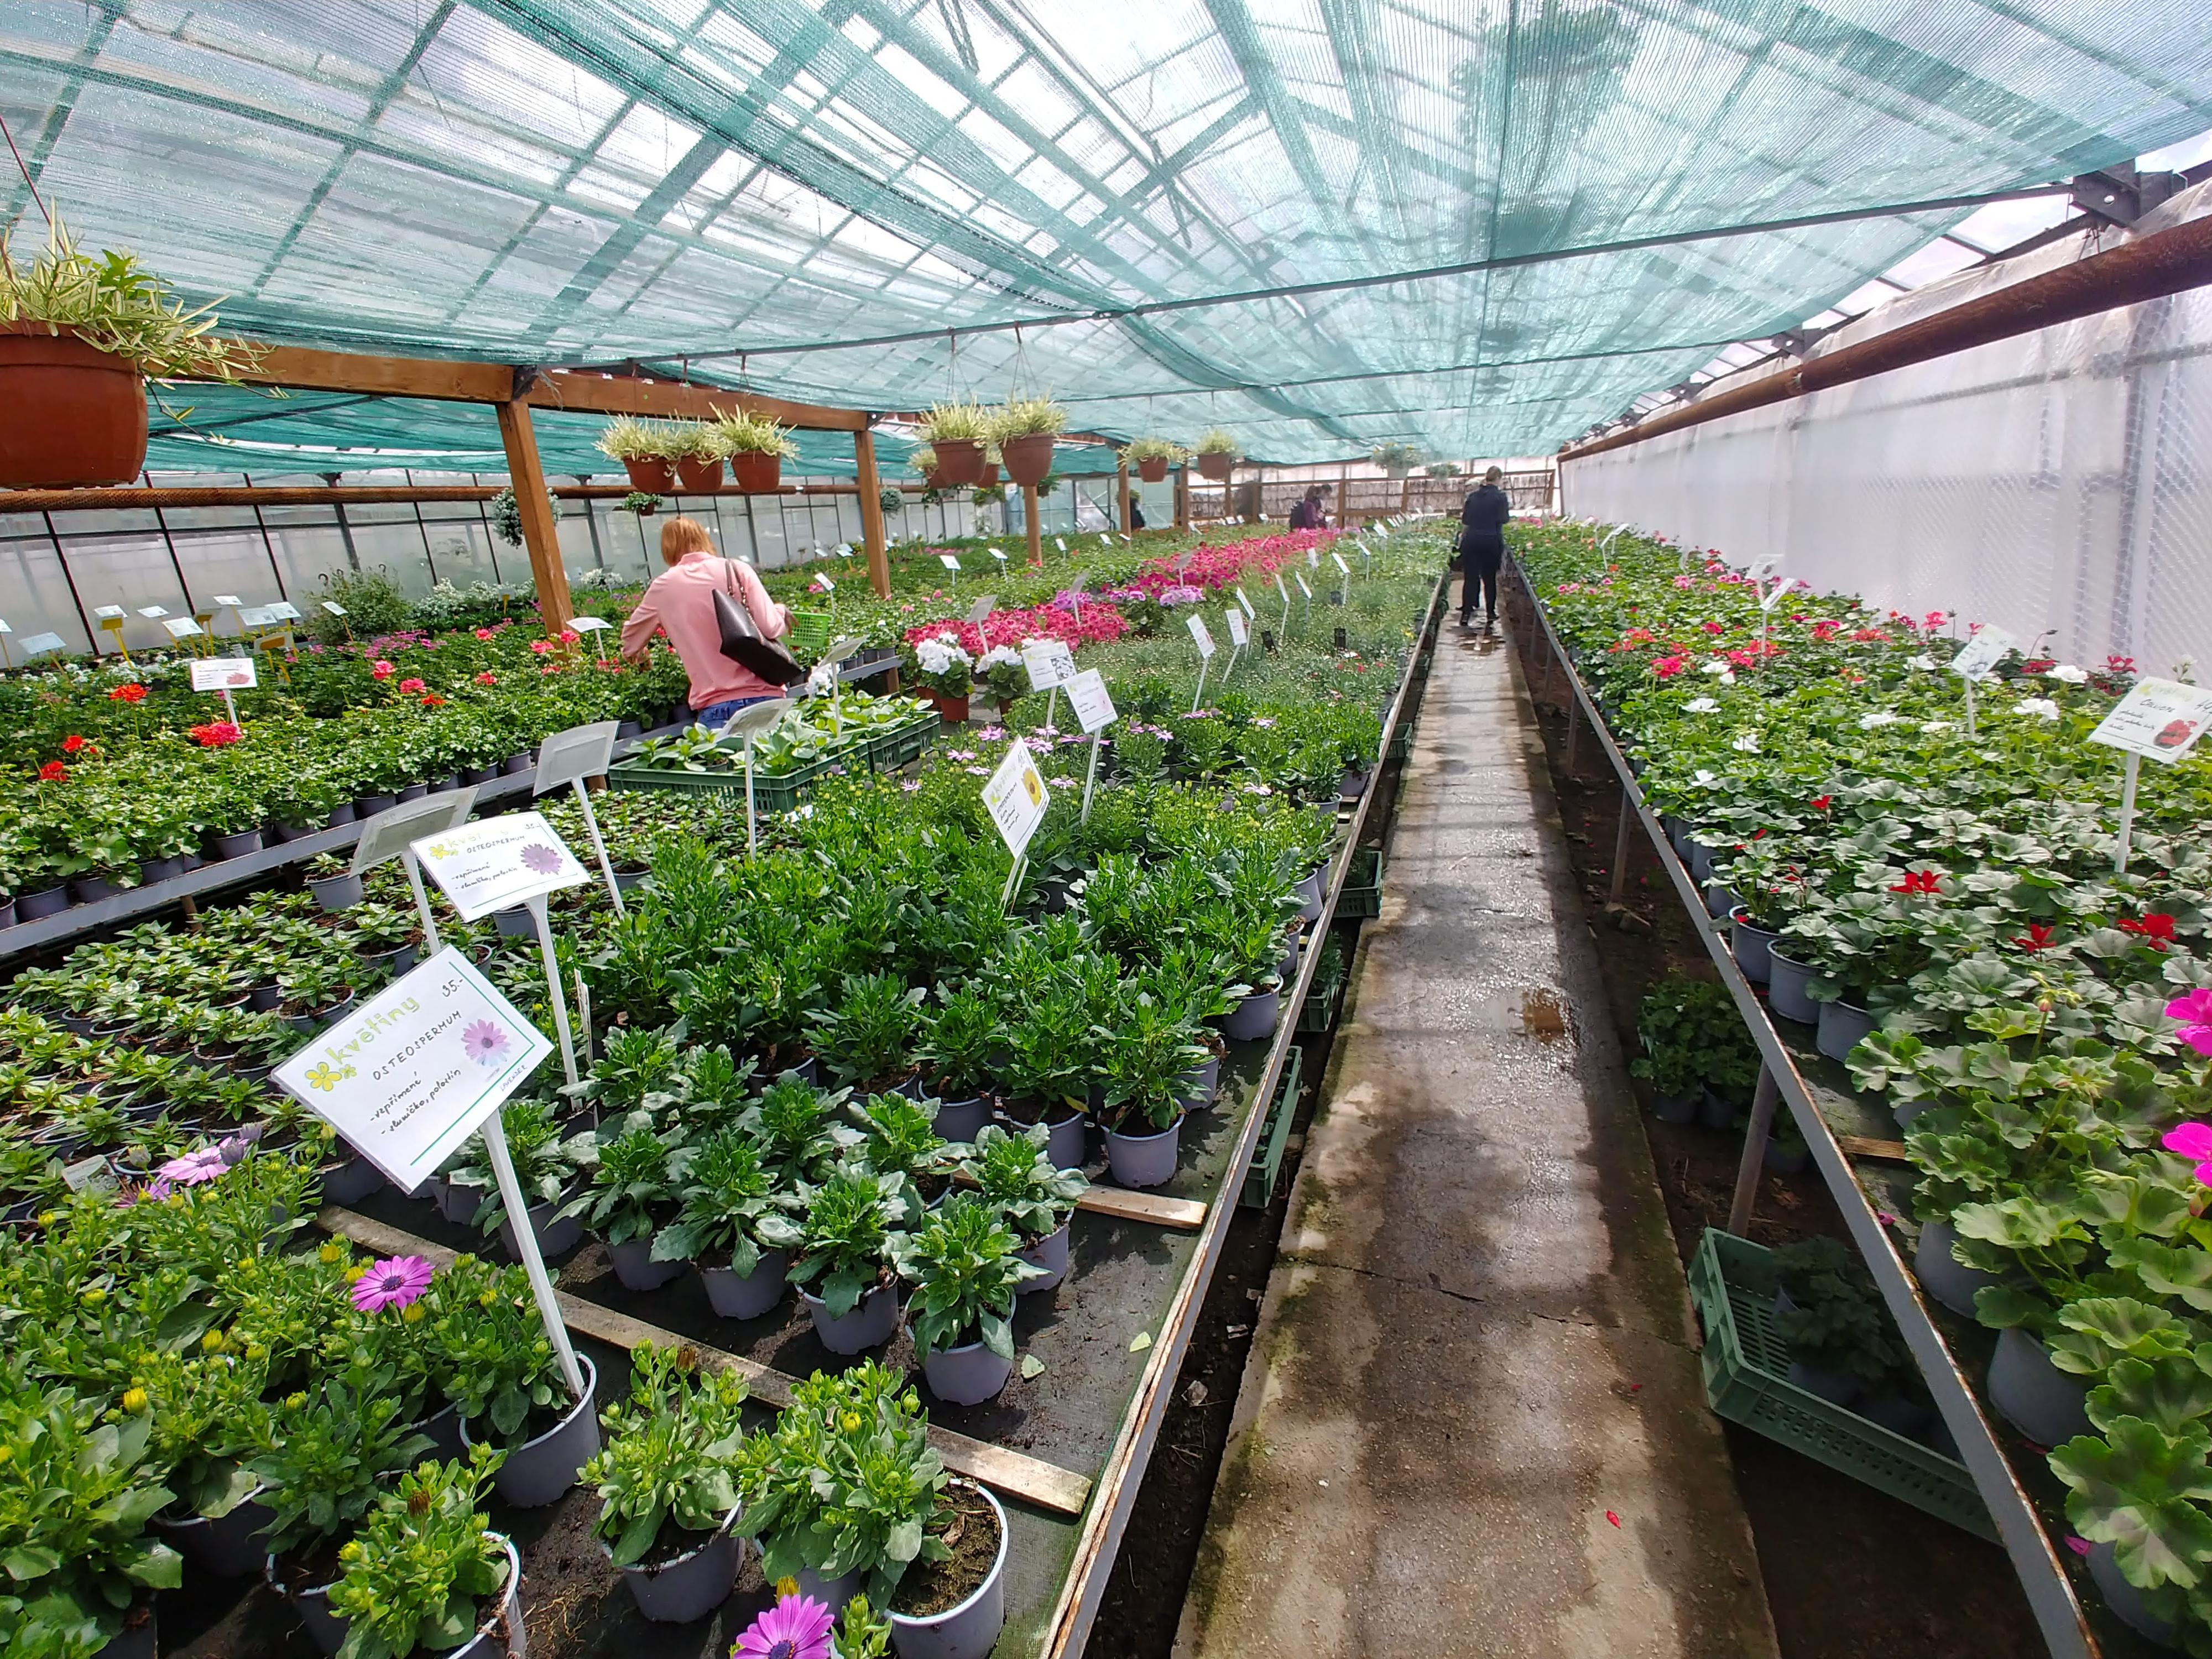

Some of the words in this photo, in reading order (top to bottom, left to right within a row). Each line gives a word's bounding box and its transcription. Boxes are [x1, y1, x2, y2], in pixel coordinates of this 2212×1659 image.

[467, 835, 525, 853] OSTEOSPERMUM
[325, 997, 420, 1065] květiny
[373, 1010, 462, 1080] OSTEOSPERMUM
